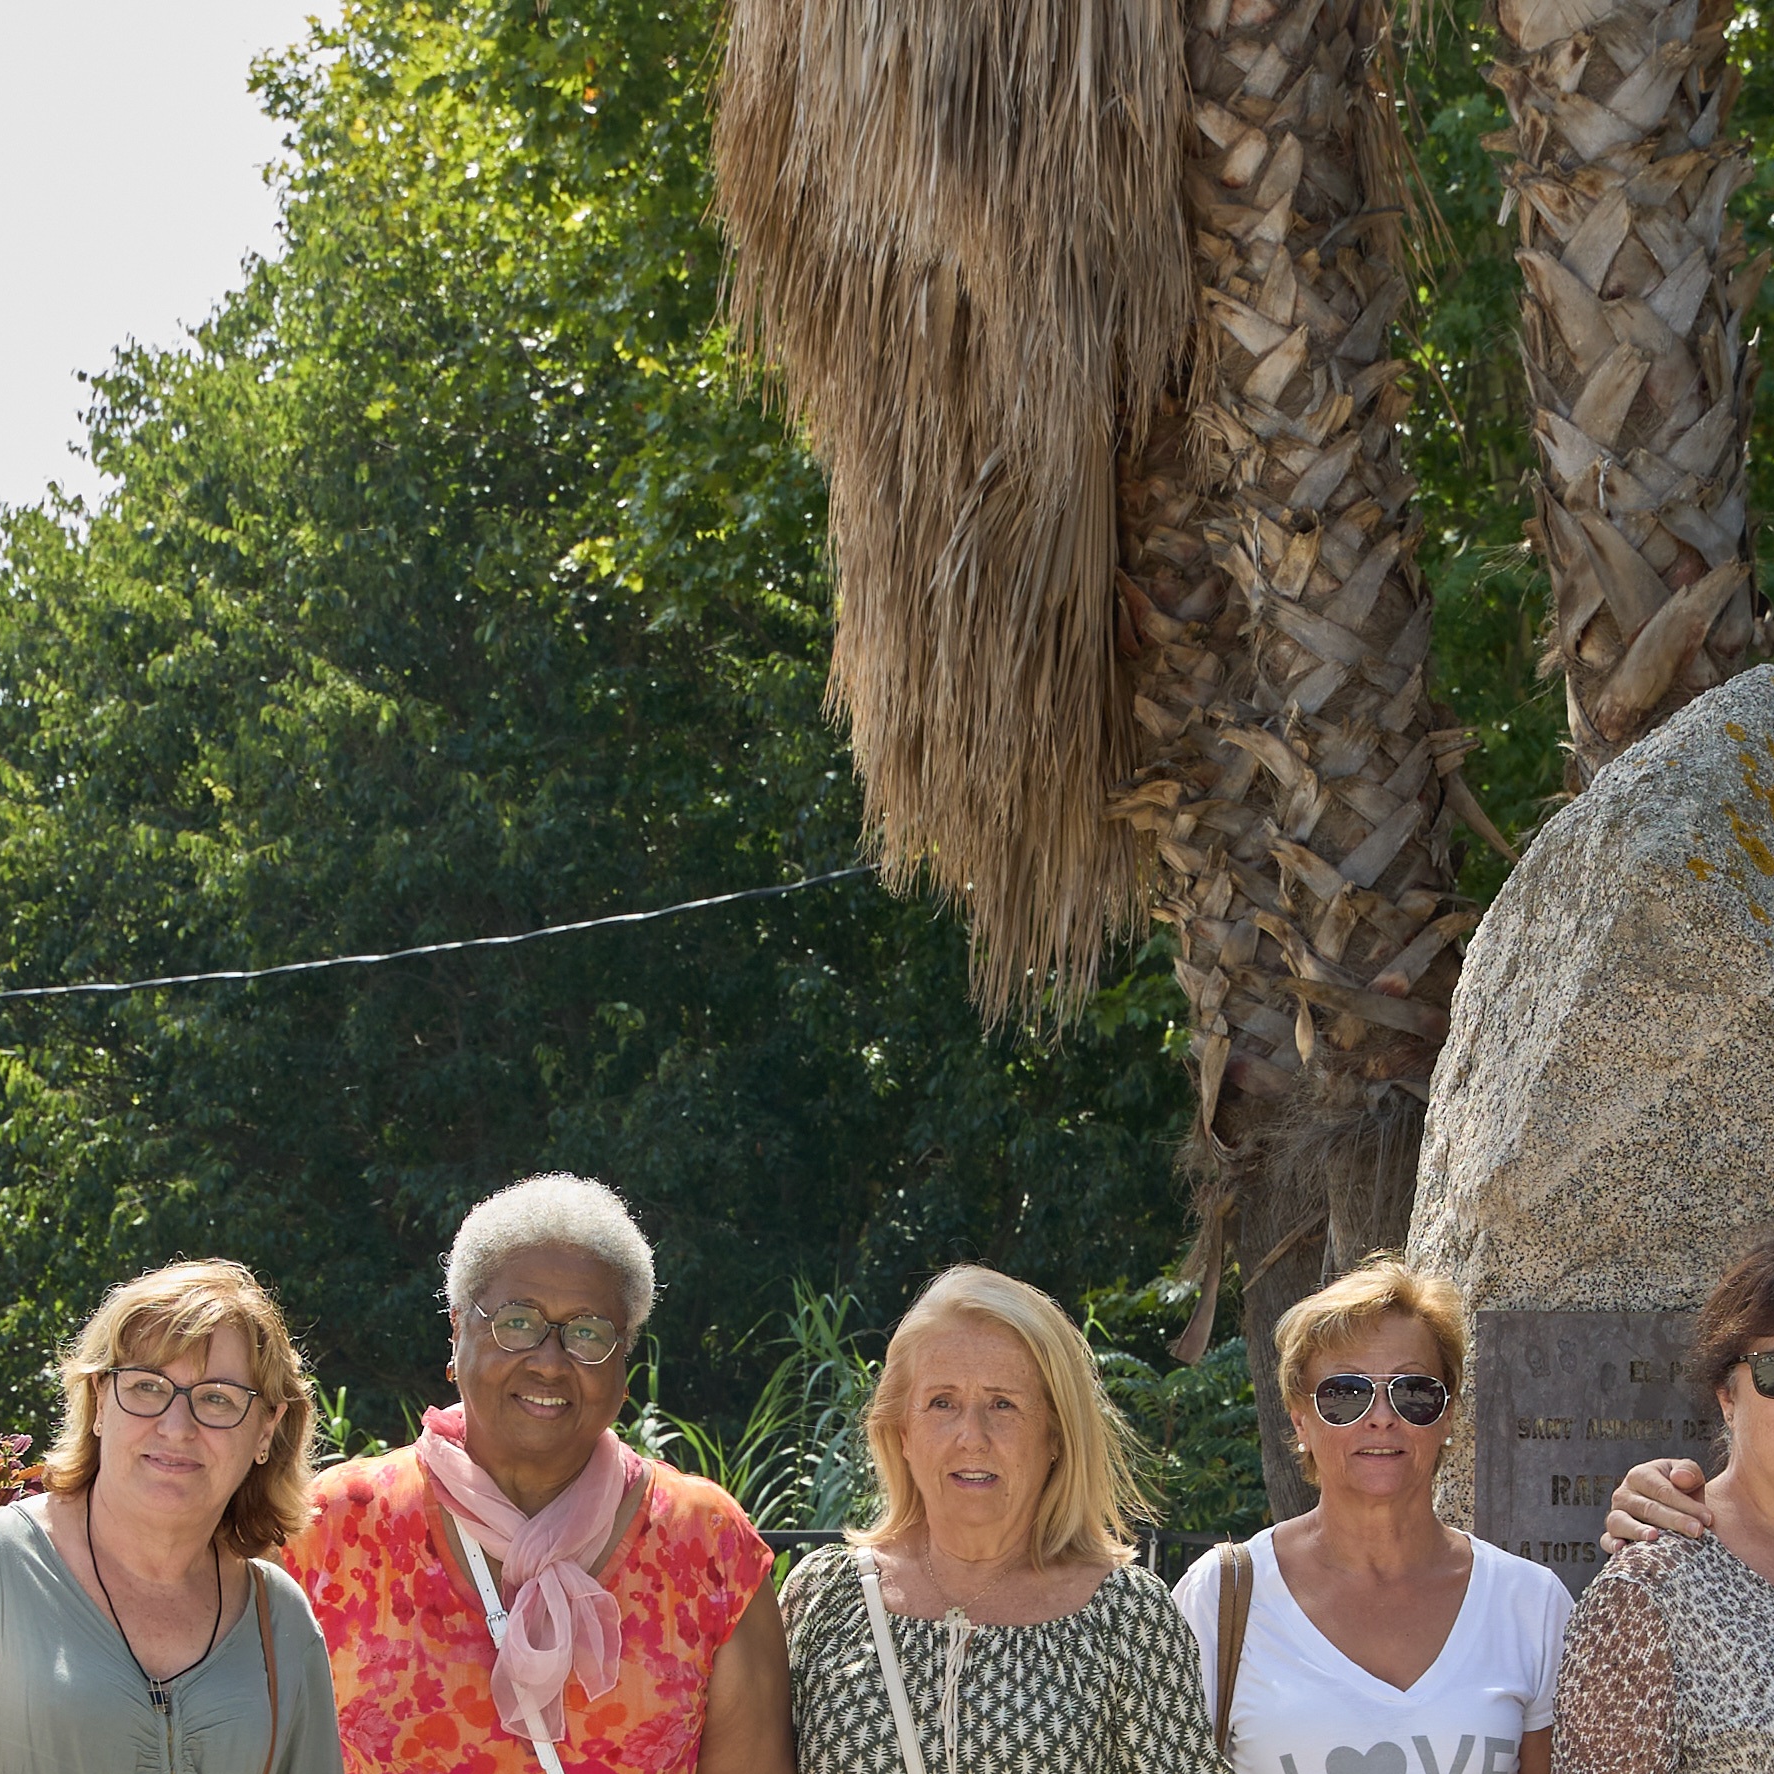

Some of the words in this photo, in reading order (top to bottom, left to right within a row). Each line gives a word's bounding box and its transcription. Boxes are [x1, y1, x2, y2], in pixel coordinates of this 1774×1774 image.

[1517, 1417, 1574, 1440] SANT
[1586, 1417, 1673, 1441] ANDREU
[1551, 1474, 1624, 1506] RAF
[1539, 1540, 1597, 1563] TOTS
